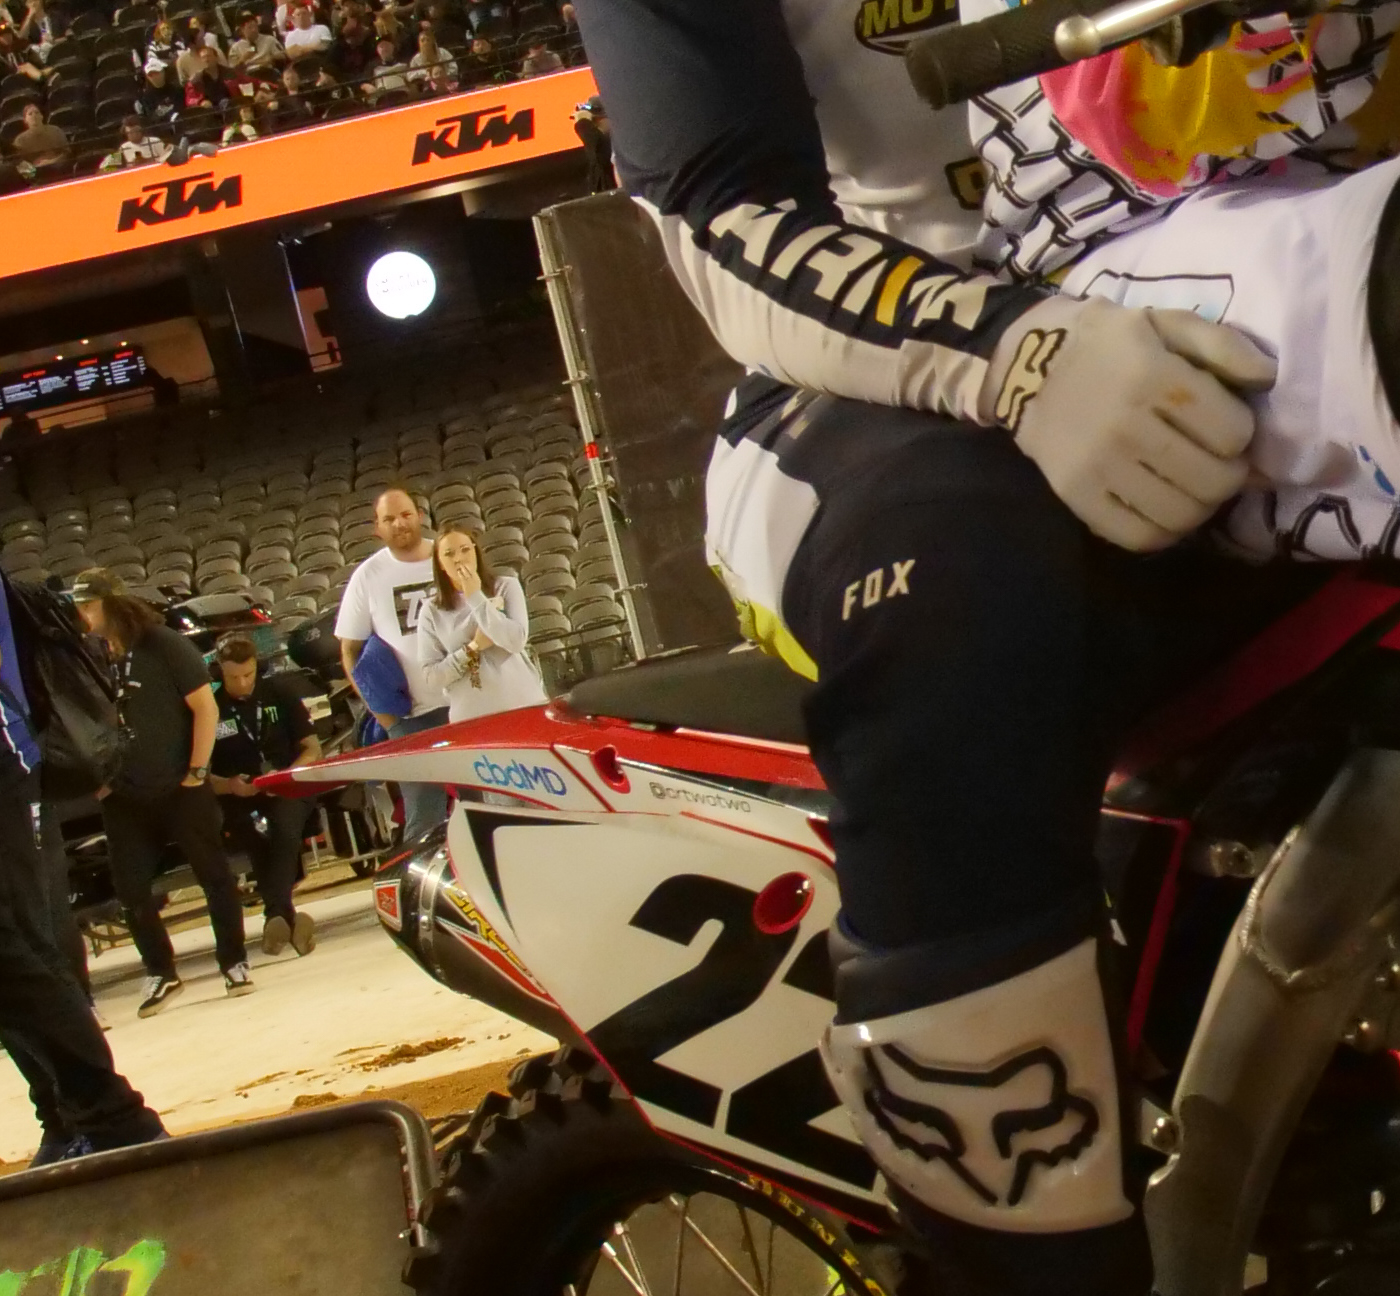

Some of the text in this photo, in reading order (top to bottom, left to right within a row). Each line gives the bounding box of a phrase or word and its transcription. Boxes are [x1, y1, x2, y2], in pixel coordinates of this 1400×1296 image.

[411, 106, 535, 165] KTM
[116, 171, 242, 232] KTM
[840, 558, 916, 621] FOX
[472, 753, 567, 797] cbdMD
